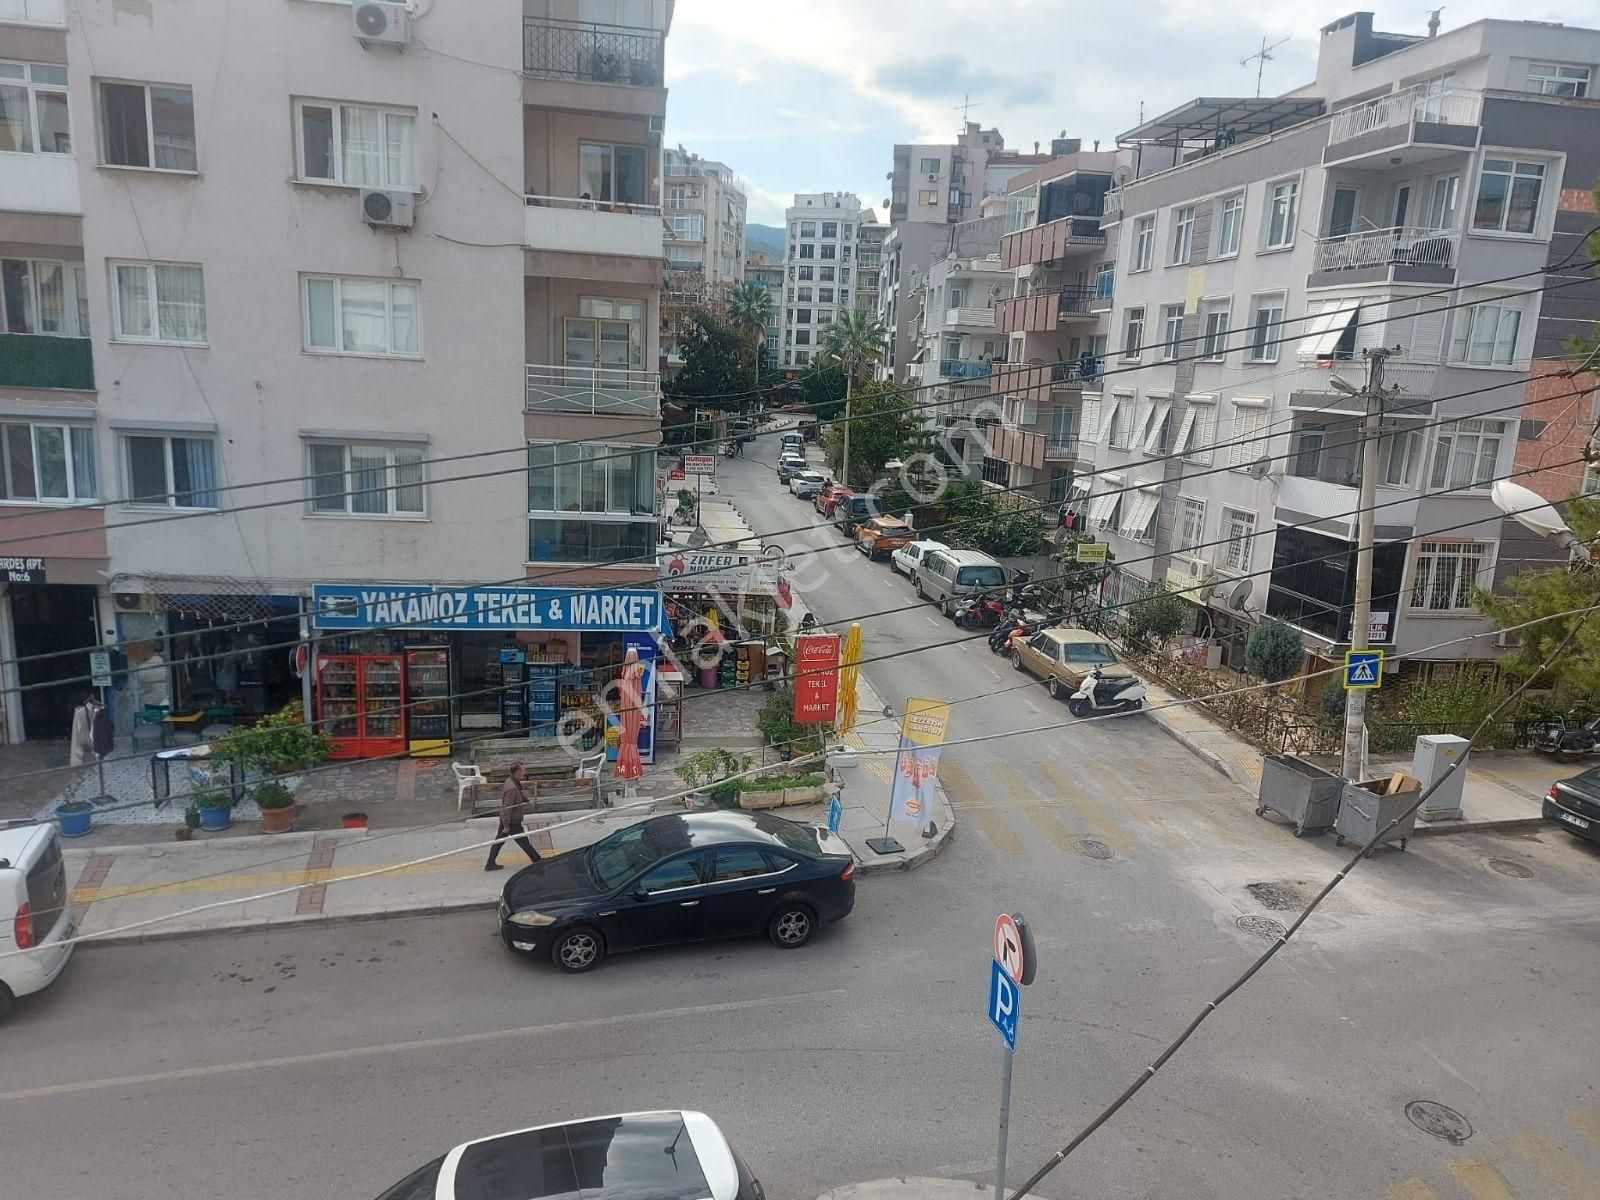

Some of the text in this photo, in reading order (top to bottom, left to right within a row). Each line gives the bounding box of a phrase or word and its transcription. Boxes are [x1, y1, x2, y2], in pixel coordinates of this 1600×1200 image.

[26, 558, 45, 570] APT.
[690, 556, 733, 565] ZAFER
[361, 592, 655, 625] YAKAMOZ TEKEL & MARKET
[802, 668, 834, 676] YAMOZ
[808, 680, 828, 688] TEKEL
[803, 703, 830, 711] MARKET
[995, 972, 1013, 1022] P
